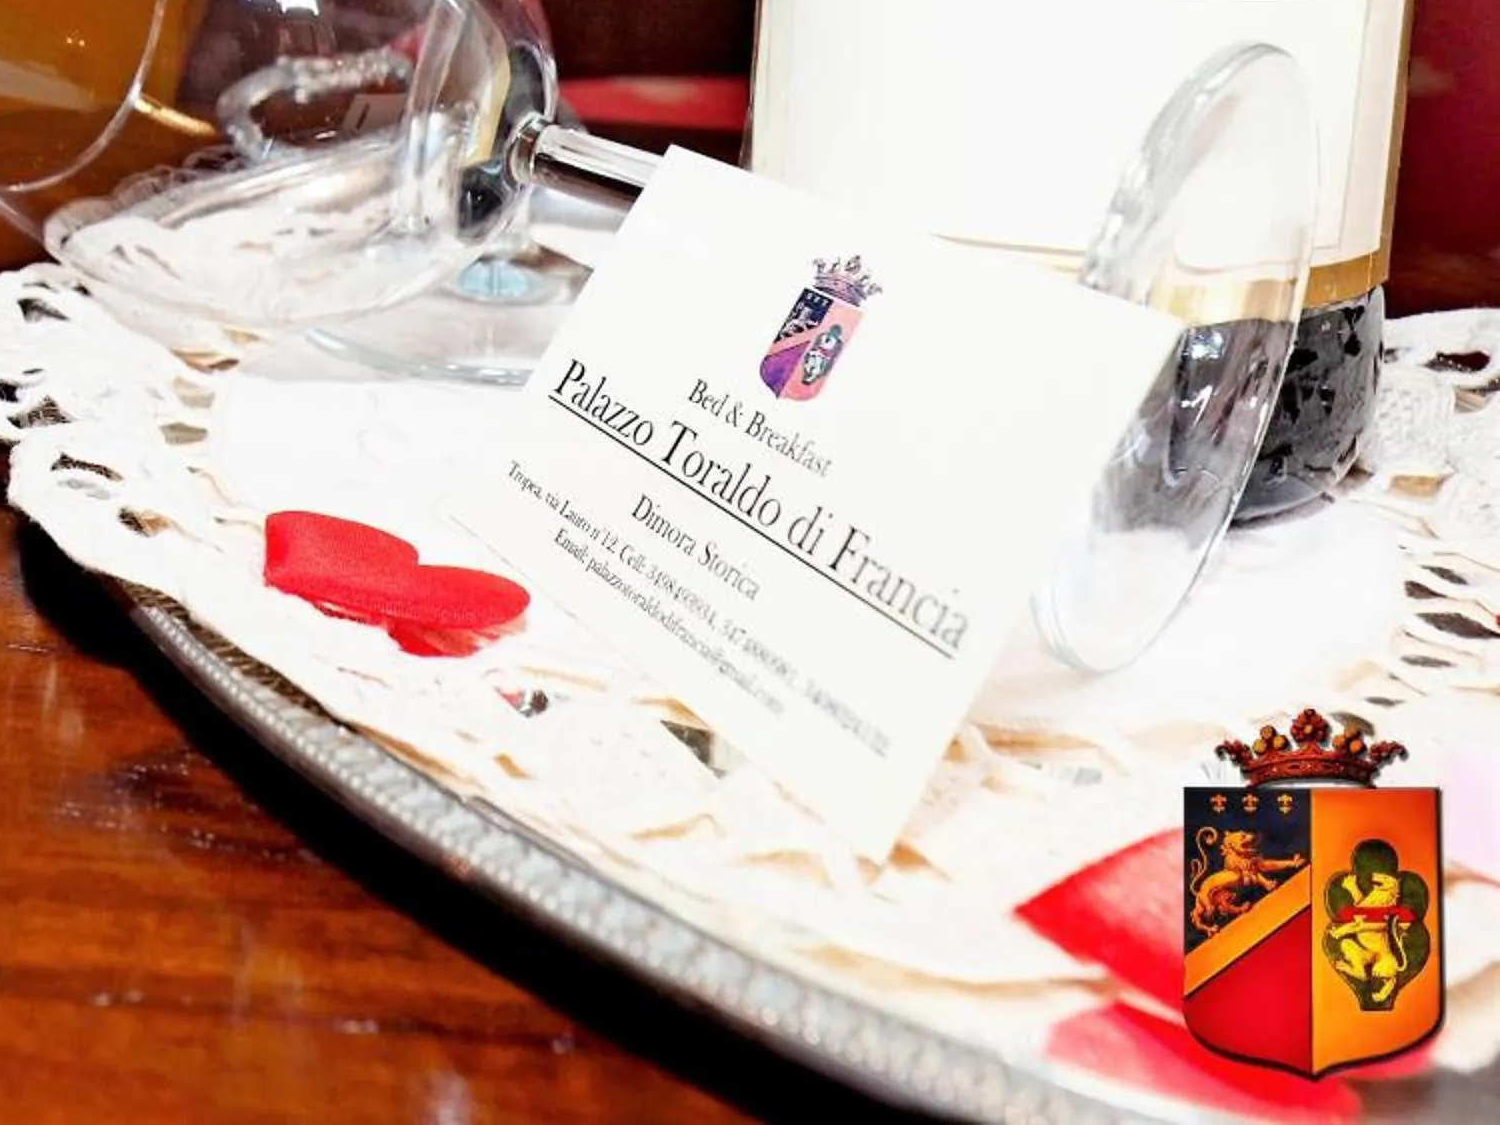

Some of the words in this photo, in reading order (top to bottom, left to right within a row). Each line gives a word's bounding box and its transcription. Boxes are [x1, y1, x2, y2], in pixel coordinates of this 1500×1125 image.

[687, 378, 729, 420] Bed
[725, 400, 745, 428] &
[745, 410, 834, 478] Breakfast
[553, 358, 654, 448] Palazzo
[661, 419, 784, 529] Toraldo
[787, 506, 835, 556] di
[828, 525, 971, 652] Francia
[553, 527, 590, 564] Email:
[558, 499, 593, 533] Lauro
[618, 543, 648, 574] Cell:
[631, 494, 698, 556] Dimora
[697, 542, 762, 601] Storica
